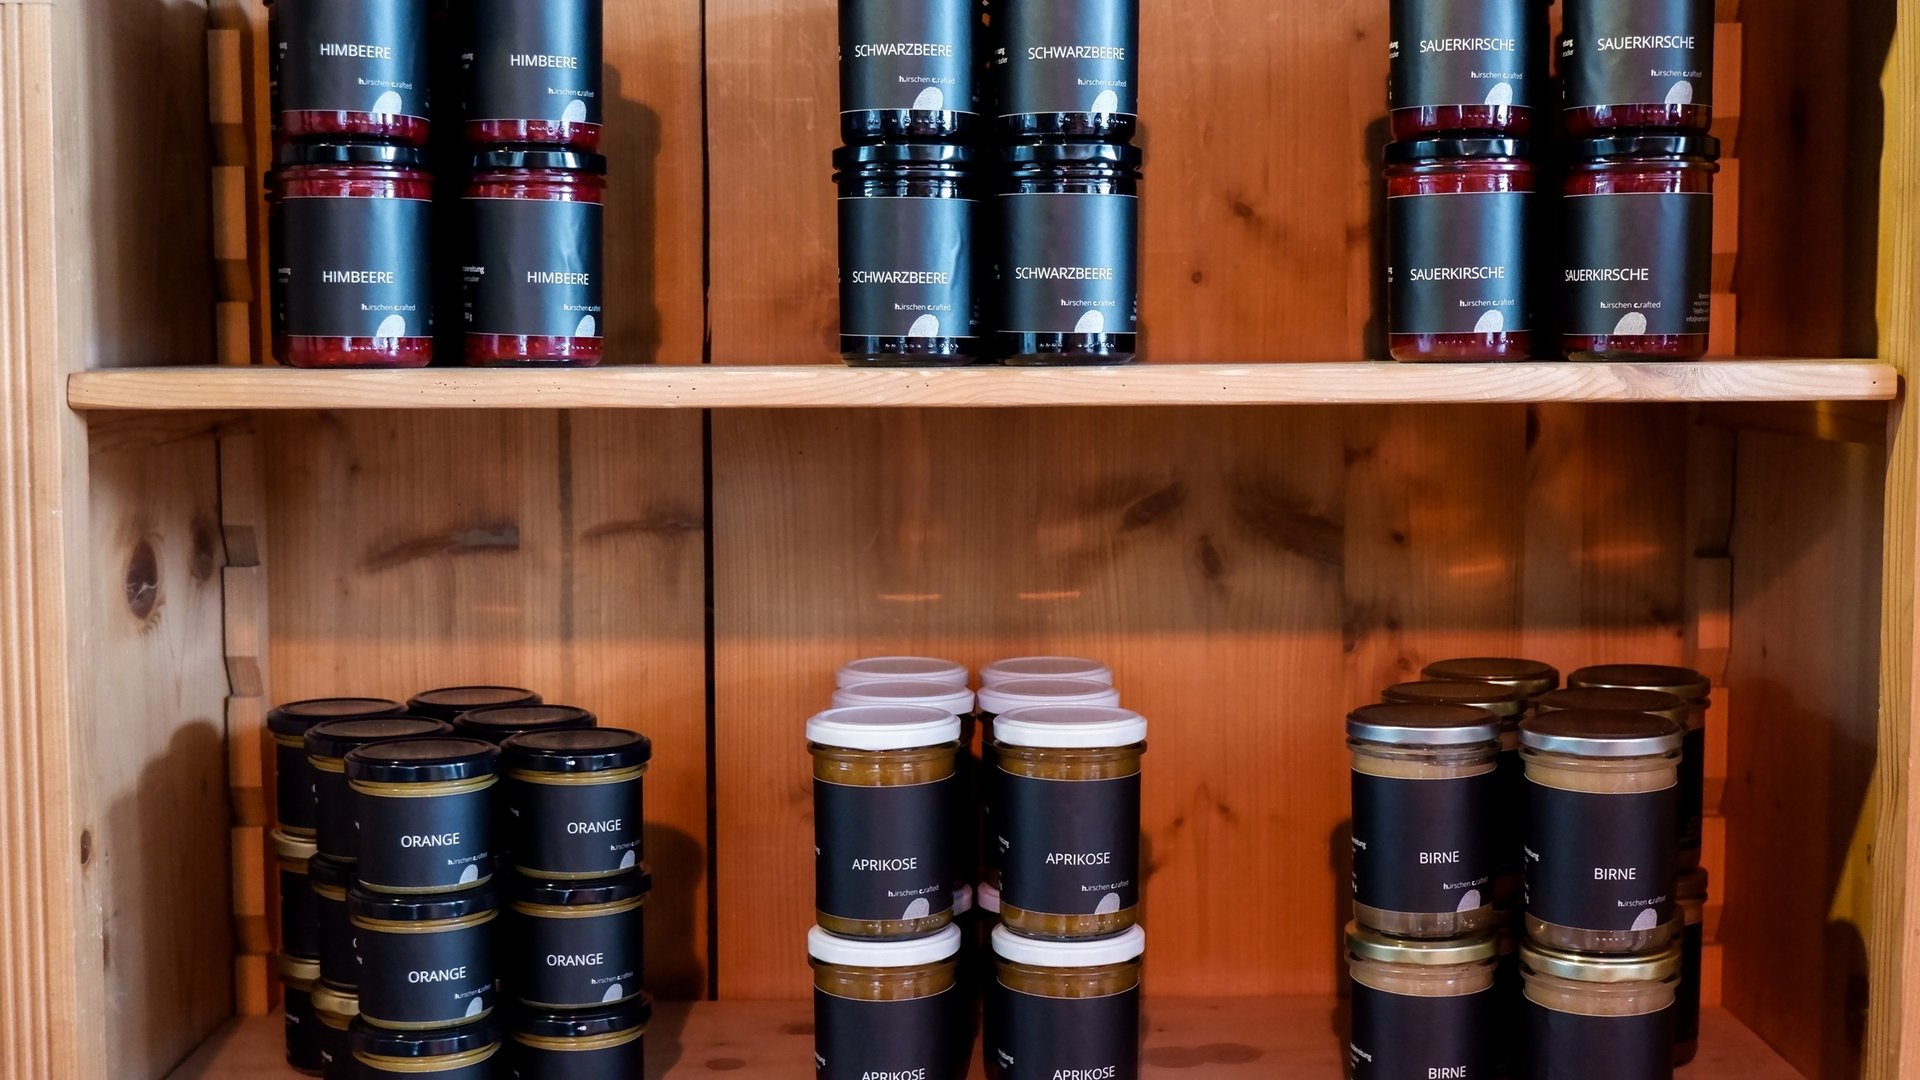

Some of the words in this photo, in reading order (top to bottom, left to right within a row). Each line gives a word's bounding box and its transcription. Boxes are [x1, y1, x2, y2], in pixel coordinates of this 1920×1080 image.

[1420, 39, 1514, 53] SAUERKIRSCHE
[1597, 36, 1694, 50] SAUERKIRSCHE
[321, 43, 391, 60] HIMBEERE
[855, 43, 952, 58] SCHWARZBEERE
[1028, 46, 1124, 61] SCHWARZBEERE
[511, 54, 577, 69] HIMBEERE
[323, 271, 394, 284] HIMBEERE
[527, 271, 589, 285] HIMBEERE
[852, 271, 947, 284] SCHWARZBEERE
[1015, 267, 1112, 280] SCHWARZBEERE
[1410, 267, 1504, 281] SAUERKIRSCHE
[1565, 268, 1648, 282] SAUERKIRSCHE
[568, 819, 621, 834] ORANGE
[401, 832, 459, 848] ORANGE
[852, 857, 917, 871] APRIKOSE
[1046, 853, 1110, 866] APRIKOSE
[1419, 851, 1459, 865] BIRNE
[1594, 868, 1636, 880] BIRNE
[547, 952, 603, 966] ORANGE
[408, 966, 466, 982] ORANGE
[862, 1068, 925, 1080] APRIKOSE
[1053, 1066, 1115, 1080] APRIKOSE
[1428, 1066, 1466, 1080] BIRNE
